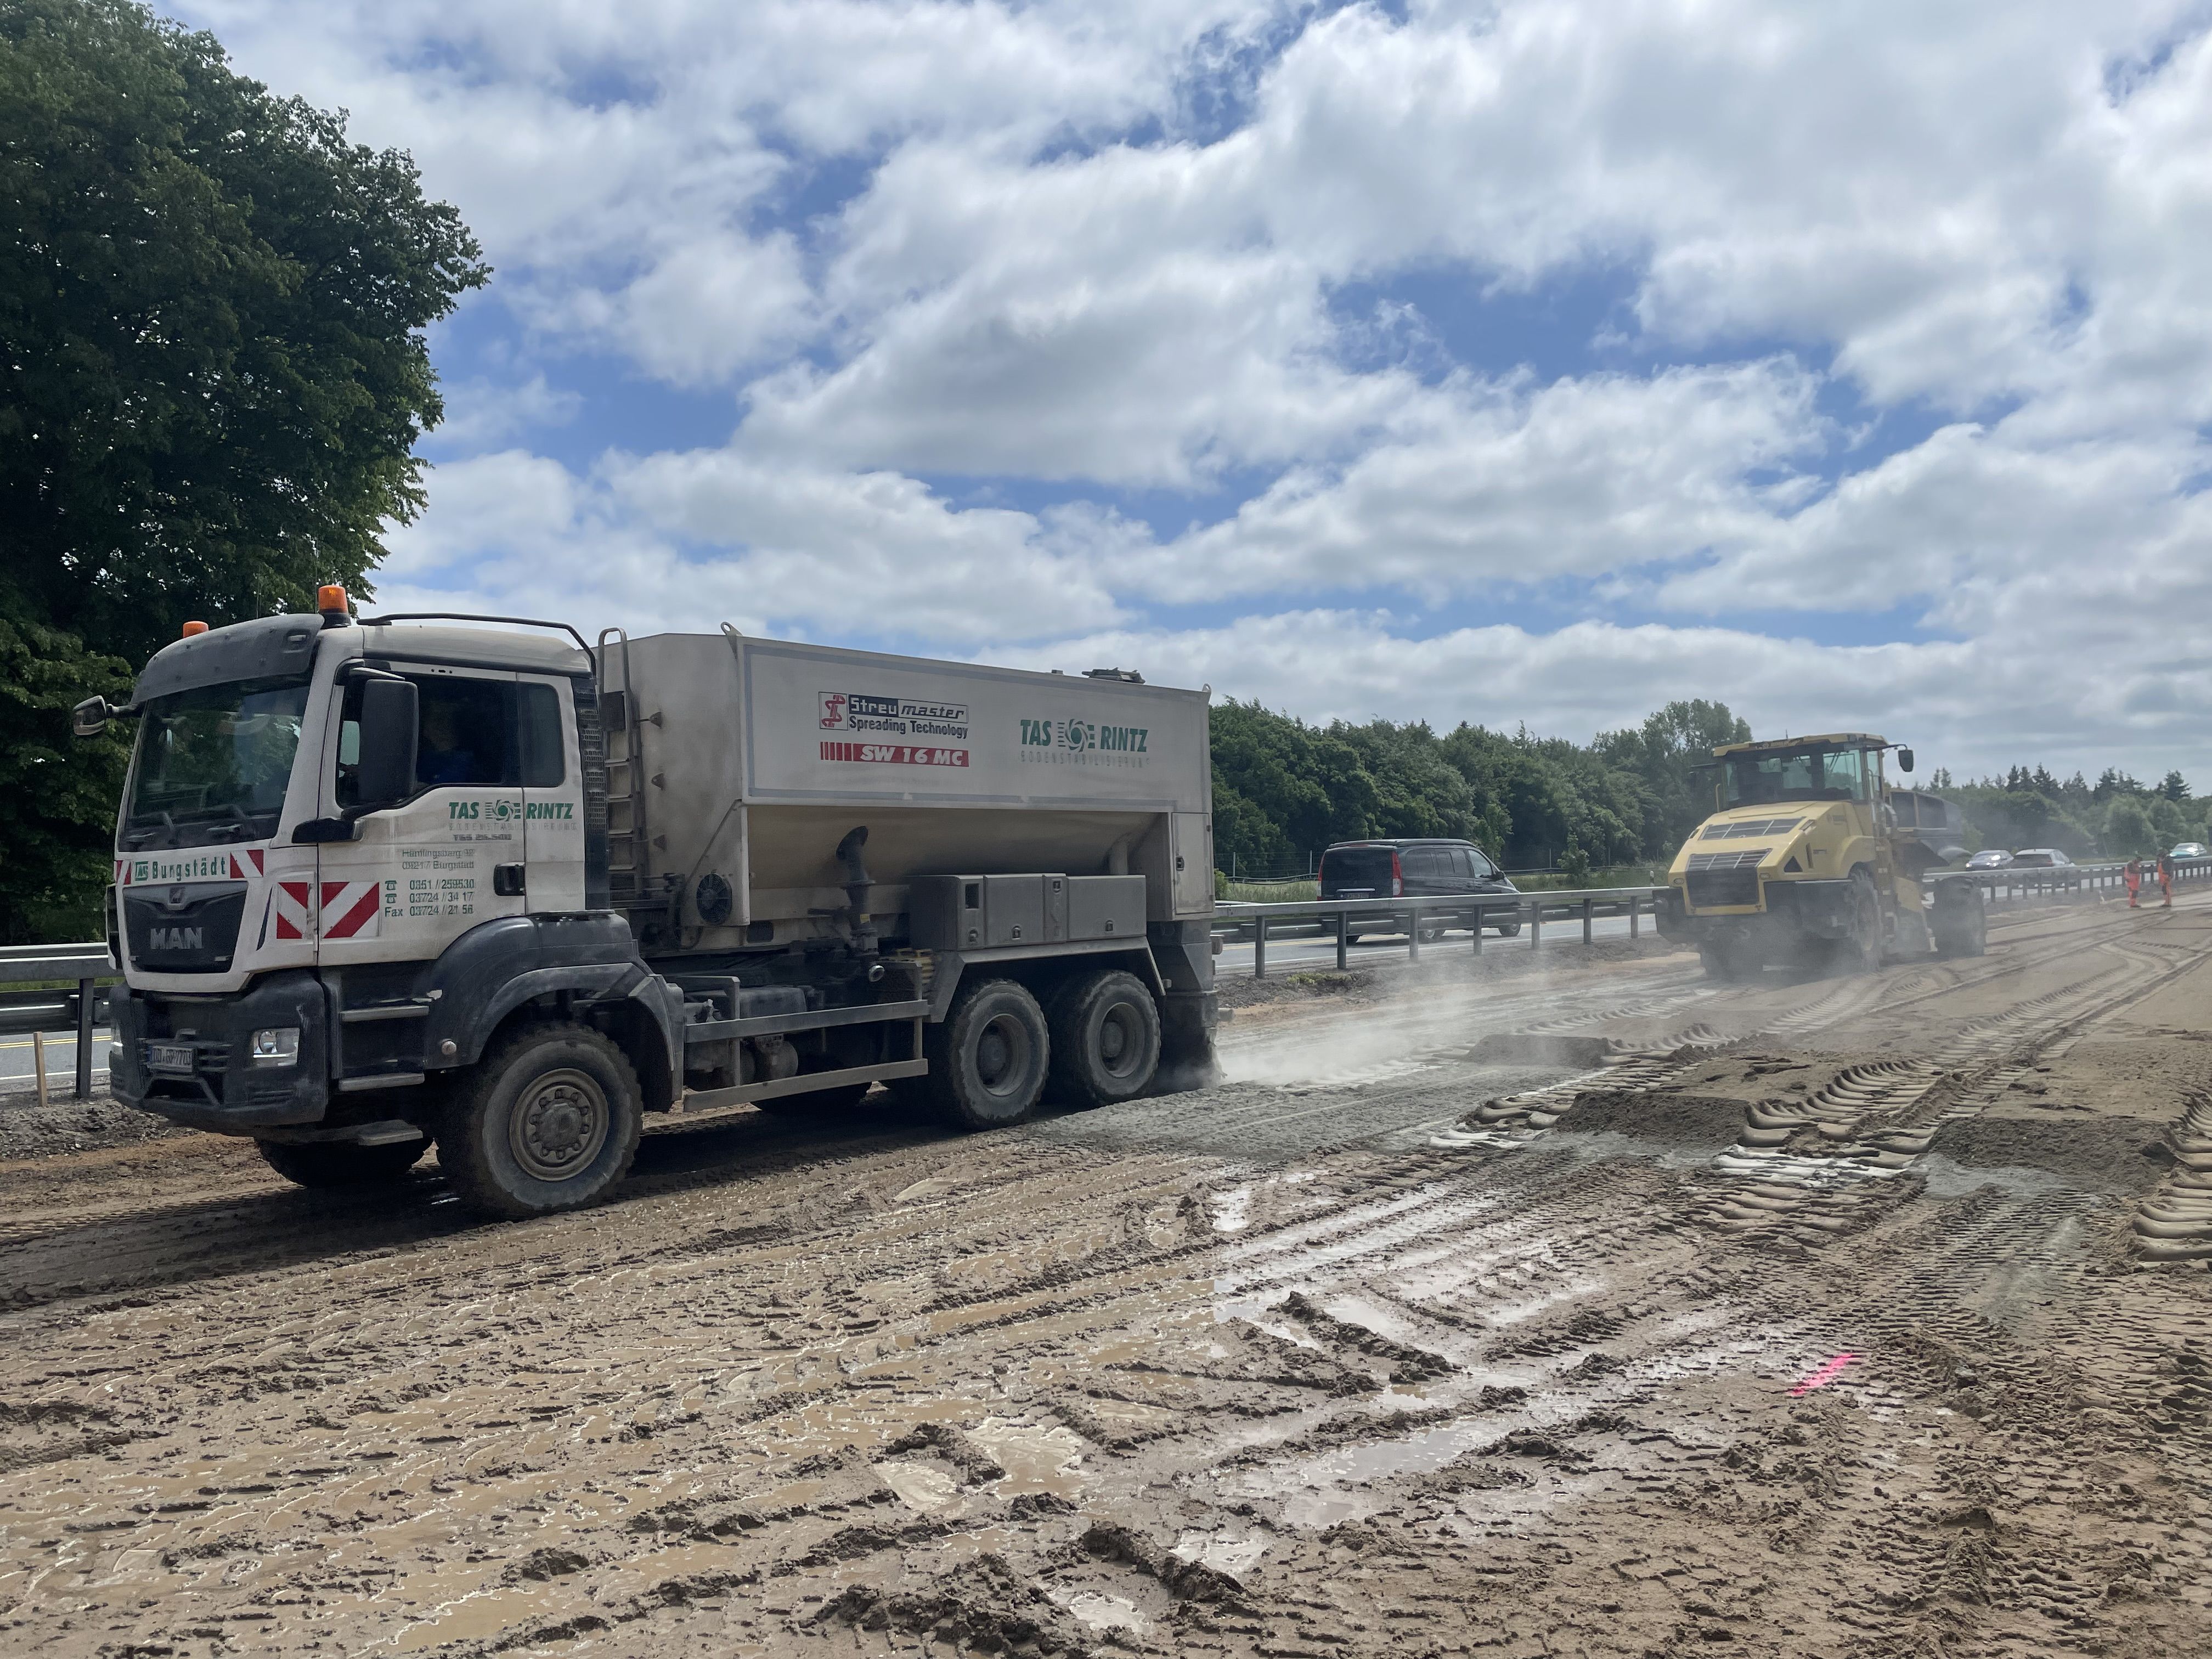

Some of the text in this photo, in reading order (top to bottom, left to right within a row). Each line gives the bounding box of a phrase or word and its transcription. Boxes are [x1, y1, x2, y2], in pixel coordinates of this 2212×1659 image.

[851, 697, 965, 719] Streu master
[849, 715, 968, 739] Spreading Technology
[1020, 719, 1148, 752] TAS RINTZ
[860, 746, 963, 765] SW 16 MC
[449, 802, 575, 820] TAS RINTZ
[153, 857, 225, 881] Burgstädt
[385, 907, 403, 917] Fax
[150, 927, 203, 950] MAN
